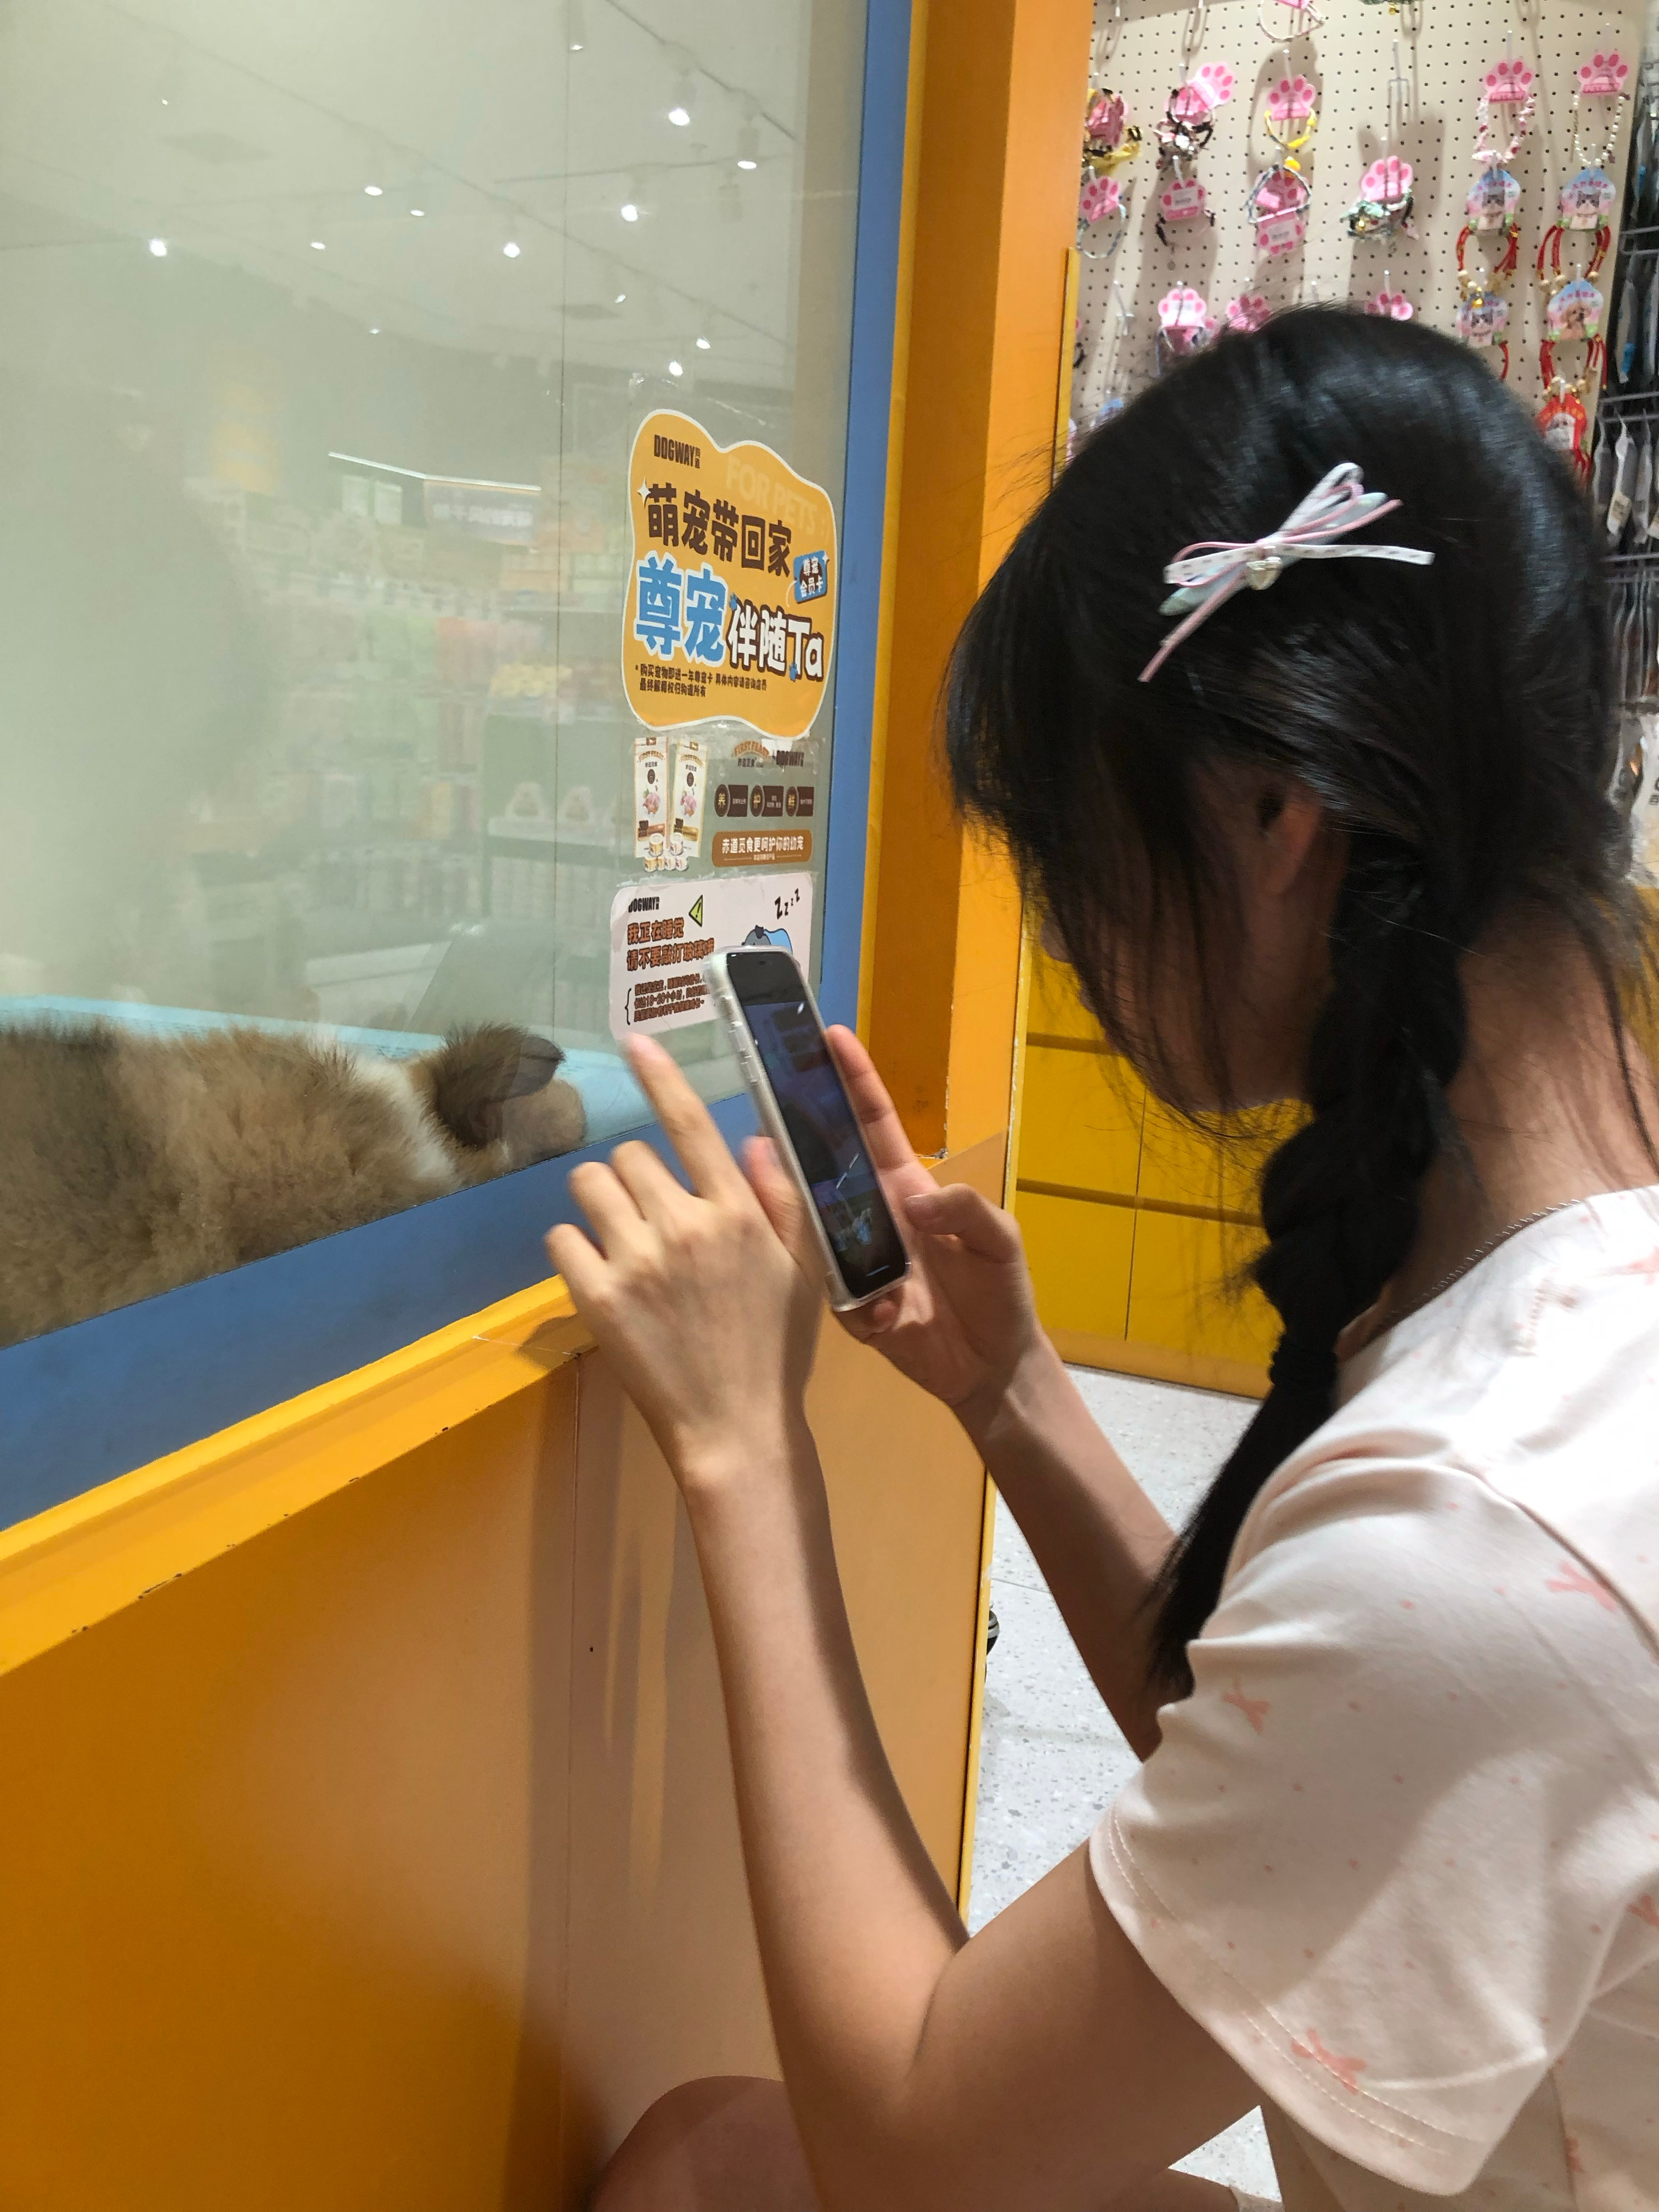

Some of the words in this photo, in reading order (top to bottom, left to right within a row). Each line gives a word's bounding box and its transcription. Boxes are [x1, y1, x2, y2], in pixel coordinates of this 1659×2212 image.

[654, 435, 695, 467] DOGWAY
[726, 454, 770, 515] FOR
[772, 483, 817, 535] PETS
[648, 482, 792, 577] 萌宠带回家
[803, 556, 819, 576] 尊宠
[800, 575, 823, 597] 会员卡
[628, 917, 685, 945] 我正在睡觉
[627, 938, 714, 971] 请不要敲打玻璃哦
